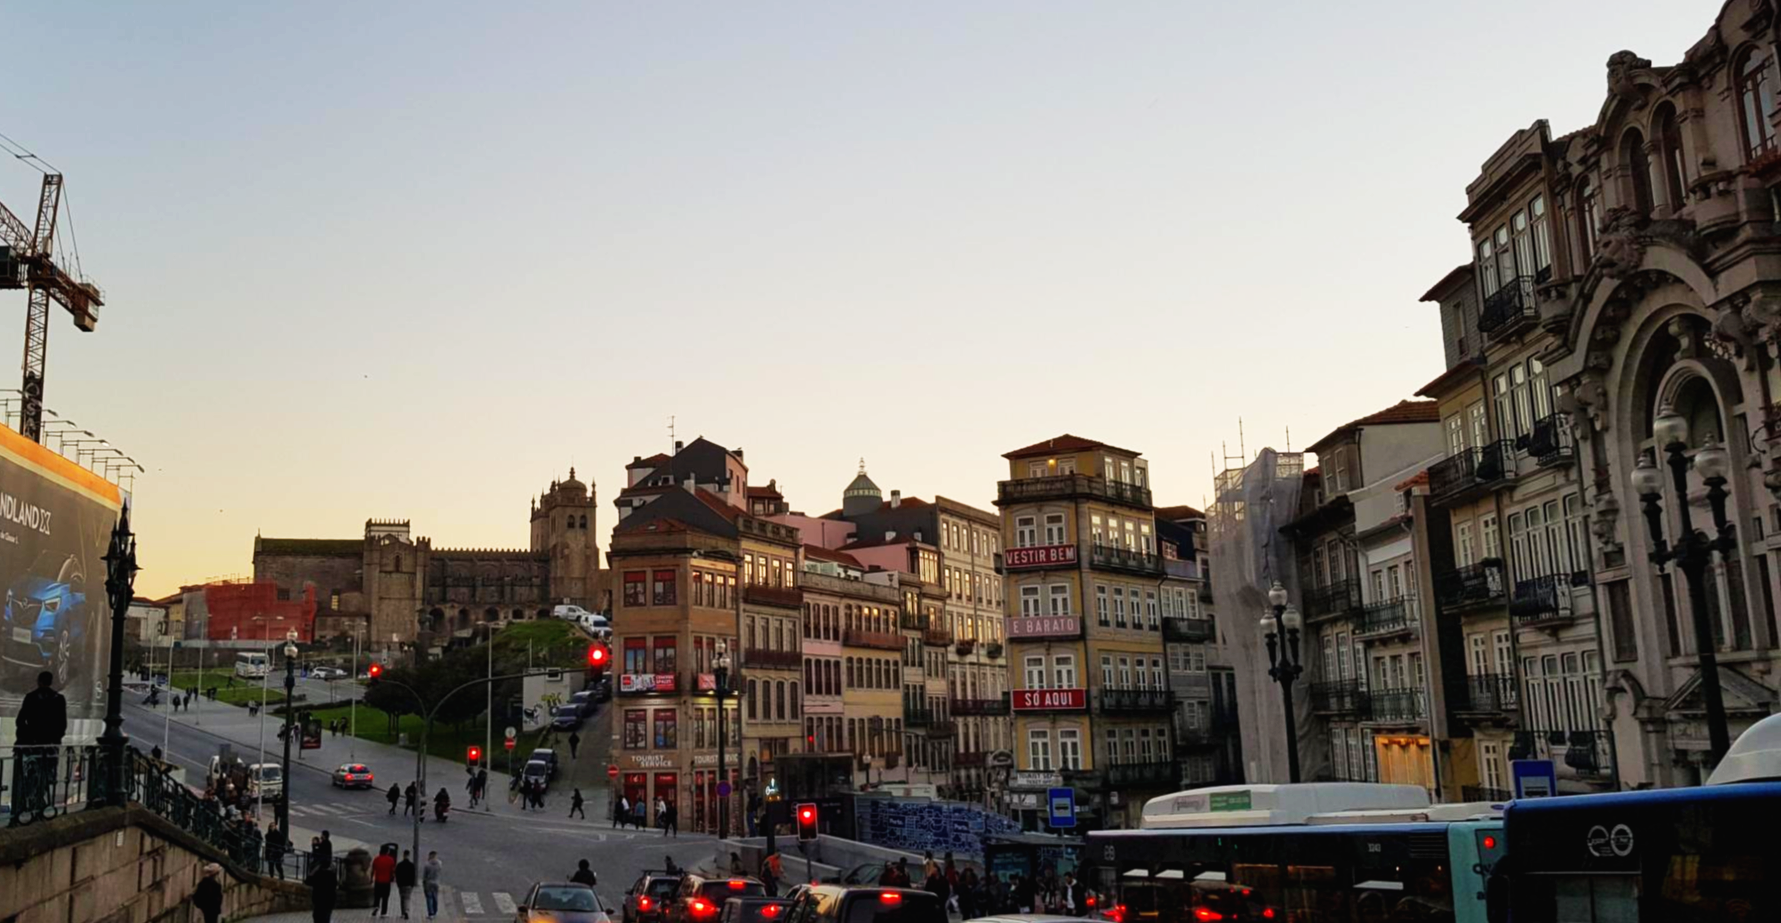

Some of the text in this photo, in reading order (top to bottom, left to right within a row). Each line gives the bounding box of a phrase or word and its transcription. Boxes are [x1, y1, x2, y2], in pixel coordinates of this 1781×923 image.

[0, 491, 40, 529] NDLAND
[1006, 547, 1074, 565] VESTIR BEM
[1013, 618, 1074, 634] E BARATO
[1025, 690, 1073, 707] SÓ AQUI
[640, 759, 672, 768] SERVICE
